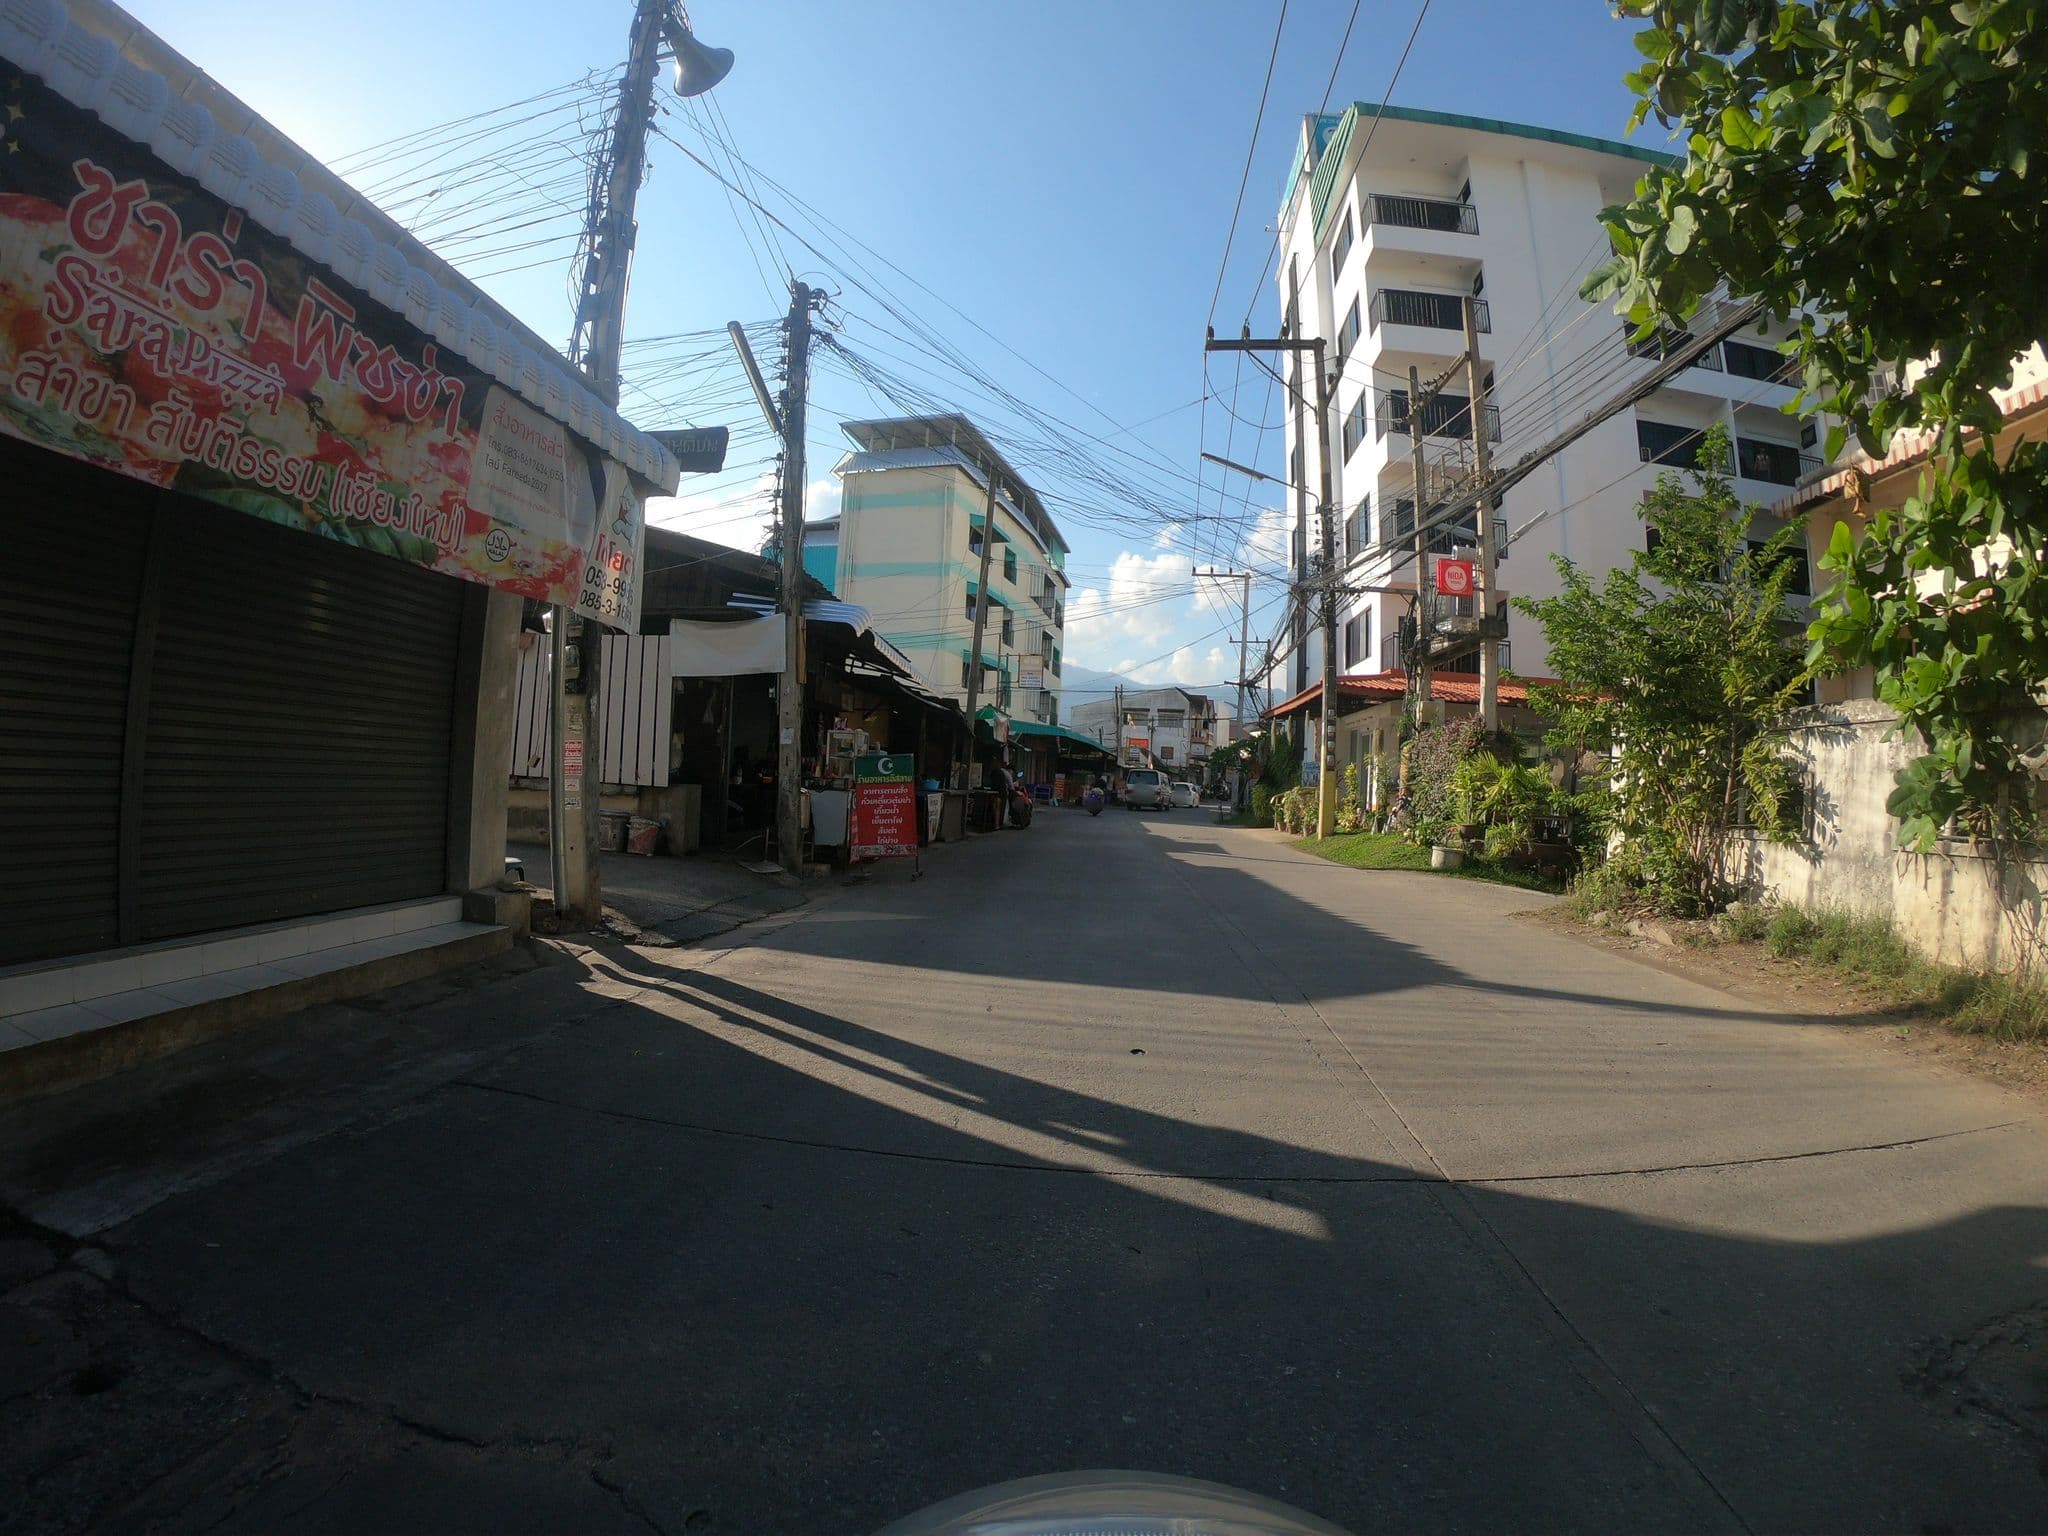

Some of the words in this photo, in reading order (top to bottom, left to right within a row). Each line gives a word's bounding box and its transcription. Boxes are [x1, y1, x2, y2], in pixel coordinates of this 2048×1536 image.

[44, 256, 172, 376] Sara
[180, 327, 285, 416] Pizza
[69, 158, 267, 342] ซาร่า
[294, 276, 465, 438] พิซซ่า
[13, 352, 136, 434] สาขา
[147, 390, 324, 500] สันติธรรม
[331, 460, 465, 551] (เชียงใหม่)
[488, 535, 507, 551] حلال
